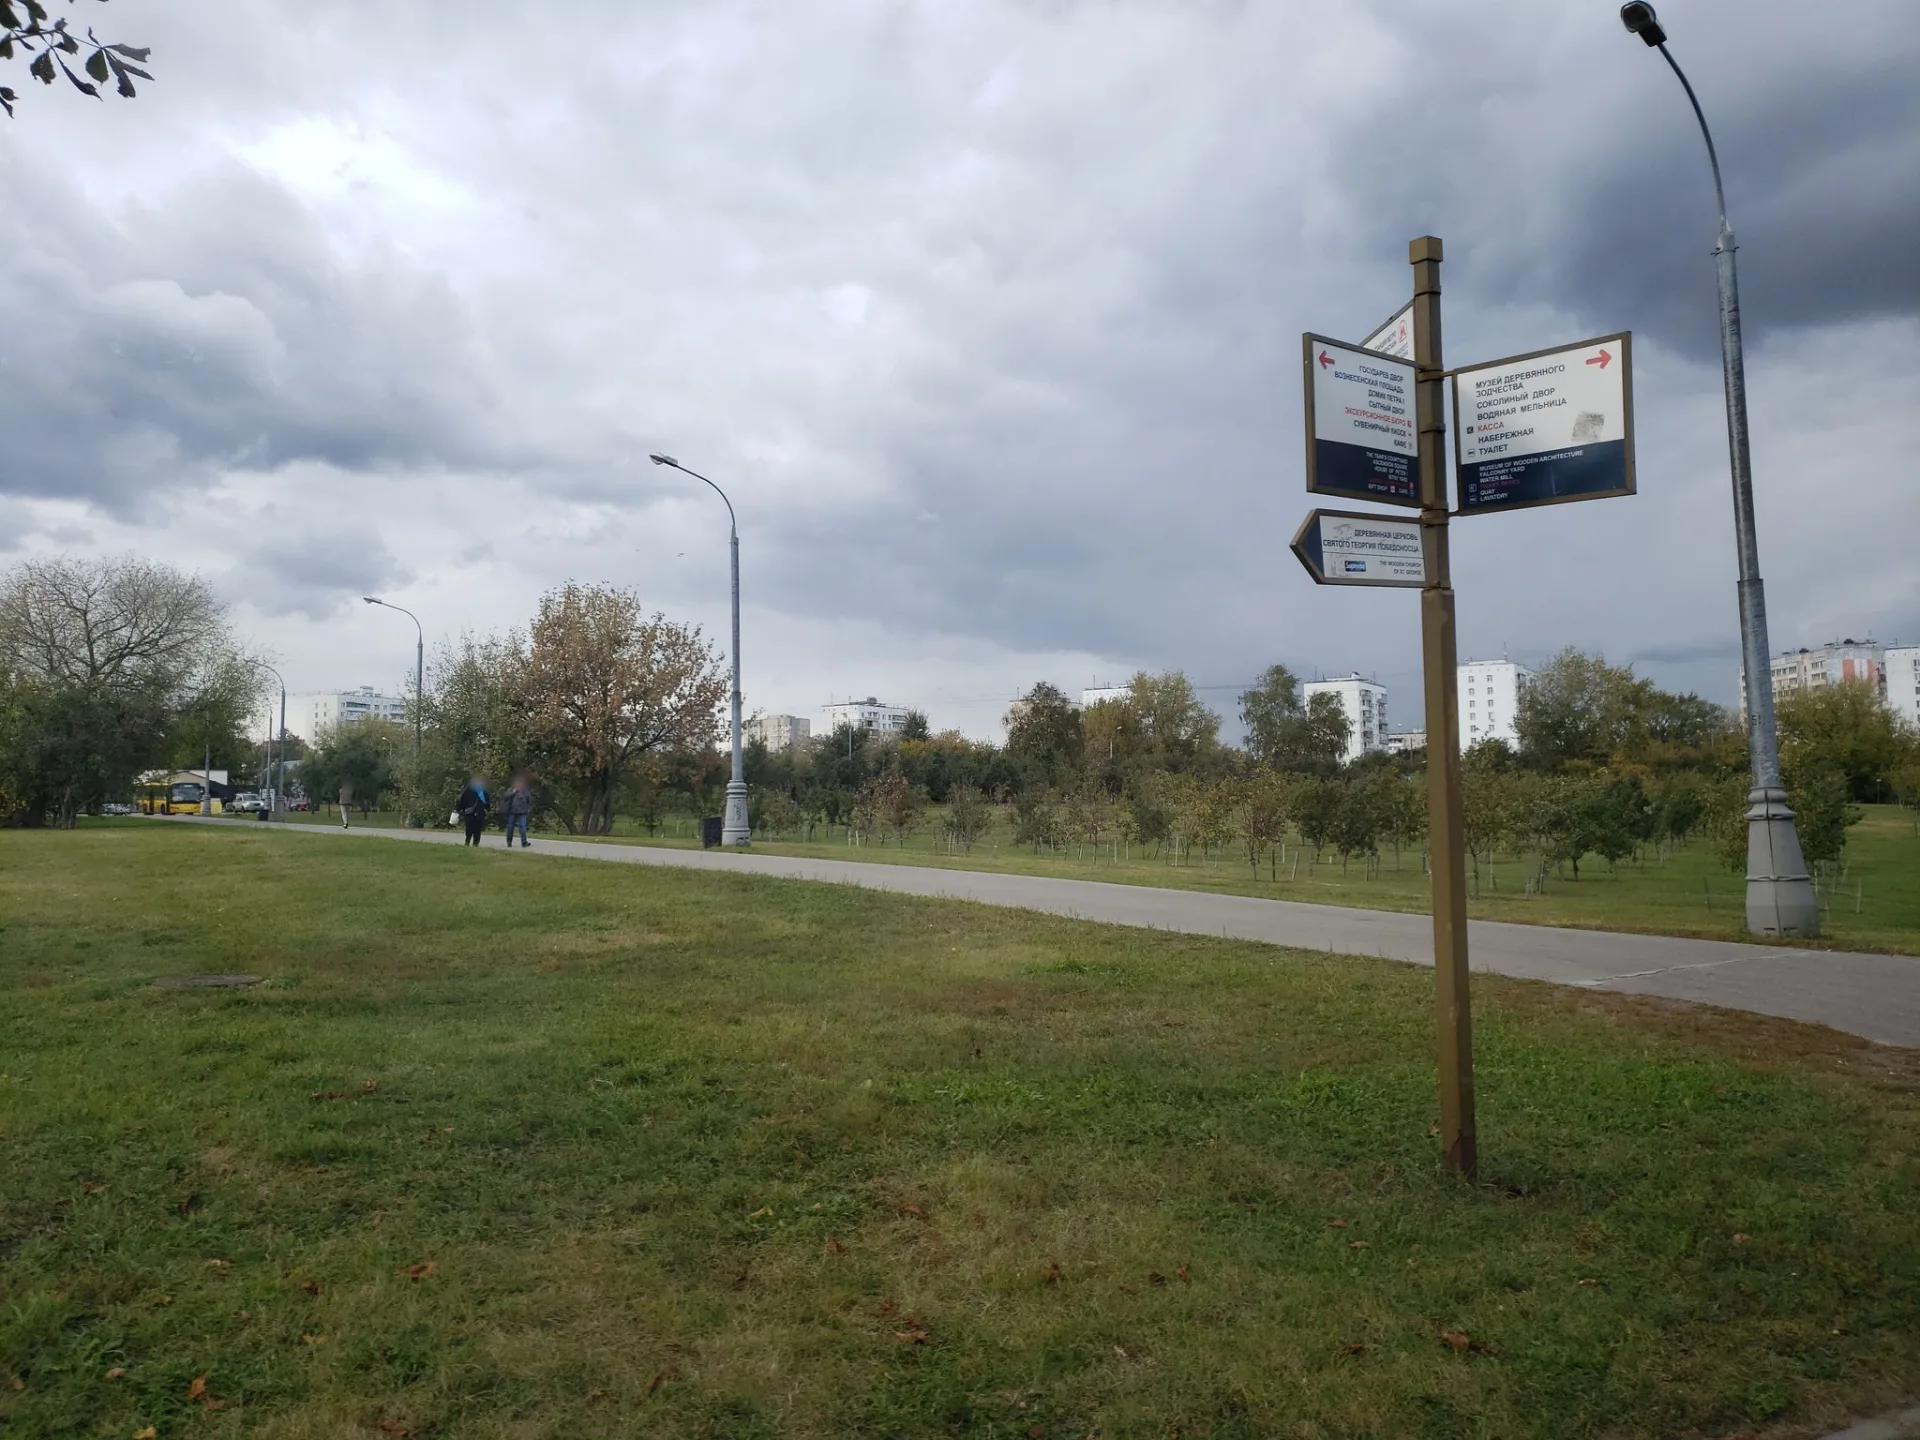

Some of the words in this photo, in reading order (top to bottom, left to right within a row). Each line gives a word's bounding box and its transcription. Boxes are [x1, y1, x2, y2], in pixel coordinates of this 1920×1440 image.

[1359, 365, 1389, 379] ГОСУДАРЕВ
[1476, 375, 1502, 389] МУЗЕЙ
[1504, 364, 1565, 384] ДЕРЕВЯННОГО
[1334, 370, 1379, 386] ВОЗНЕСЕНСКАЯ
[1379, 381, 1404, 394] ПЛОЩАДЬ
[1368, 389, 1386, 400] ДОМИК
[1387, 394, 1402, 404] ПЕТРА
[1476, 382, 1524, 398] ЗОДЧЕСТВА
[1476, 391, 1529, 409] СОКОЛИНЫЙ
[1532, 387, 1556, 400] ДВОР
[1344, 407, 1391, 422] ЭКСКУРСИОННОЕ
[1368, 400, 1391, 412] СЫТНЫЙ
[1391, 406, 1405, 415] ДВОР
[1477, 407, 1516, 421] ВОДЯНАЯ
[1520, 397, 1567, 412] МЕЛЬНИЦА
[1353, 420, 1390, 433] СУВЕНИРНЫЙ
[1390, 428, 1407, 437] КИОСК
[1478, 421, 1504, 432] КАССА
[1478, 427, 1534, 444] НАБЕРЕЖНАЯ
[1478, 444, 1508, 455] ТУАЛЕТ
[1479, 463, 1504, 472] MUSEUM
[1513, 457, 1539, 466] WOODEN
[1539, 449, 1584, 462] ARCHITECTURE
[1479, 475, 1500, 484] WATER
[1480, 488, 1496, 496] QUAY
[1480, 492, 1508, 502] LAVATORY
[1354, 529, 1392, 539] ДЕРЕВЯННАЯ
[1392, 532, 1418, 541] ЦЕРКОВЬ
[1322, 539, 1351, 548] СВЯТОГО
[1351, 541, 1377, 550] ГЕОРГИЯ
[1377, 542, 1420, 553] ПОБЕДОНОСЦА
